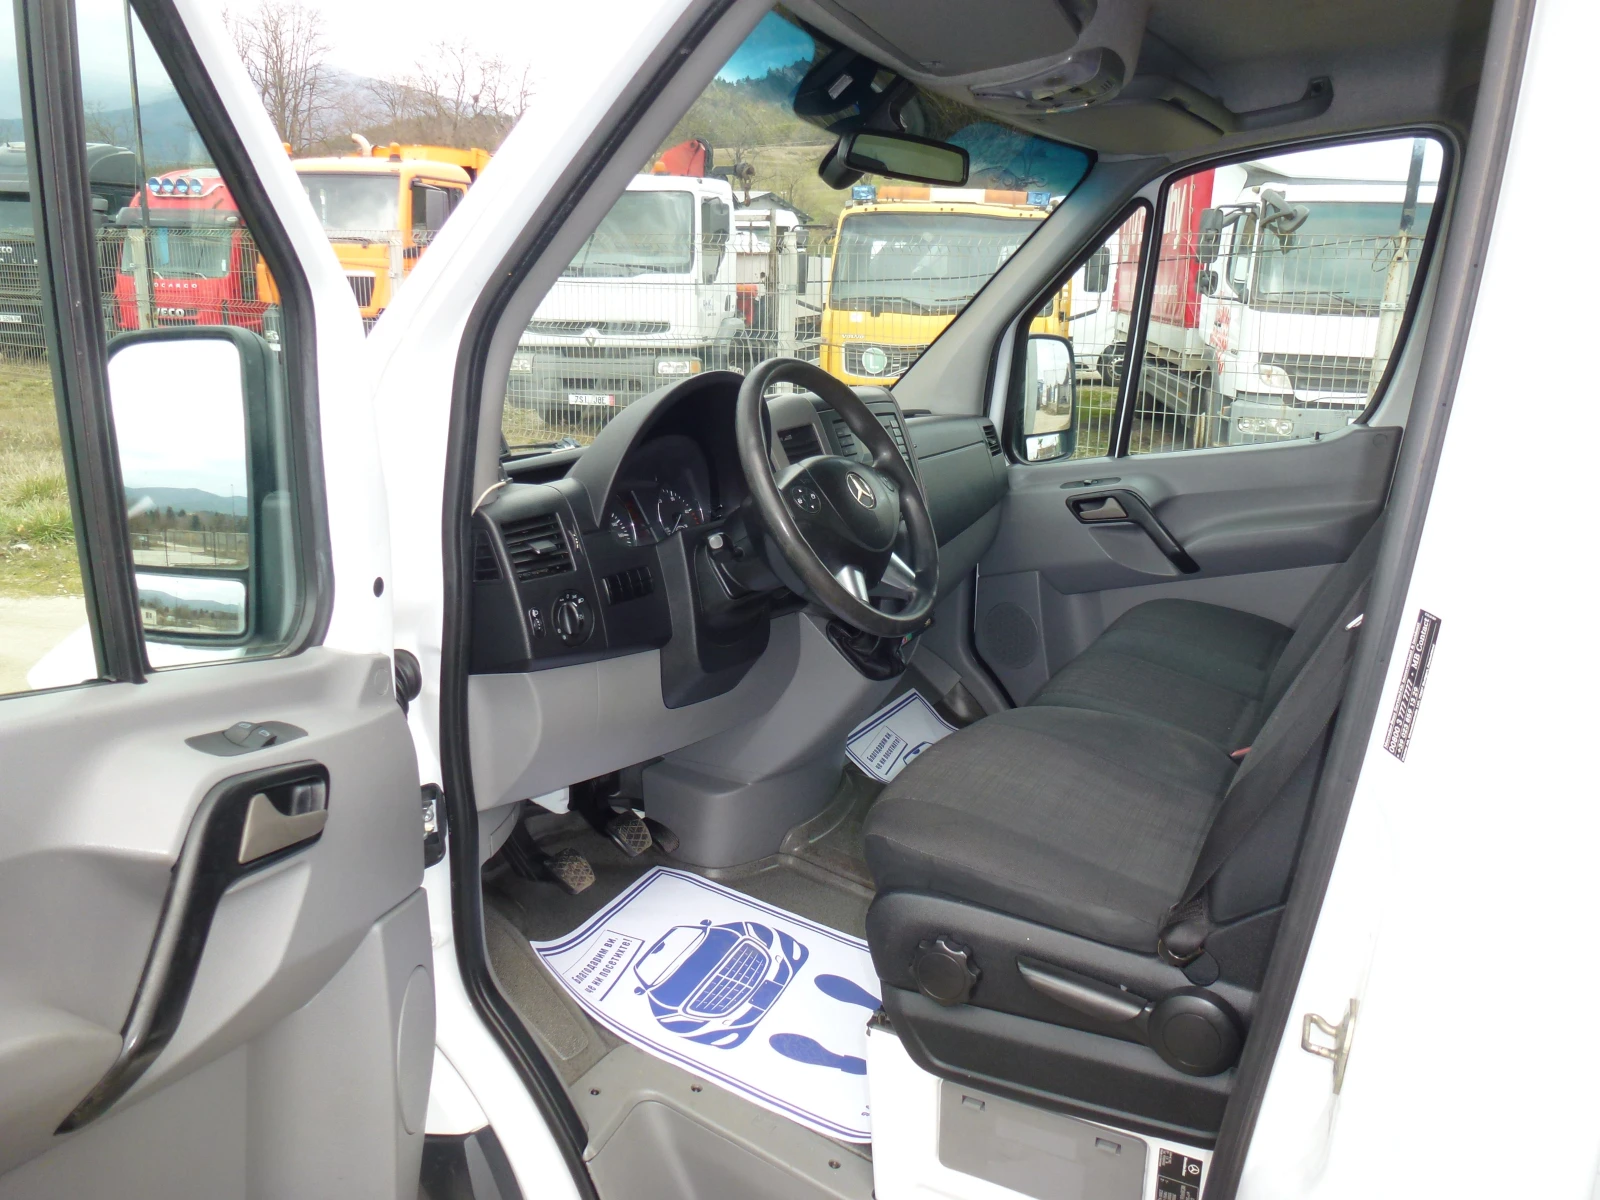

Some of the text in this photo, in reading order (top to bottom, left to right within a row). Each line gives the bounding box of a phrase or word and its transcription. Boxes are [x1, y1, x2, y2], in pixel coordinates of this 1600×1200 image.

[1415, 616, 1430, 652] Contact
[1411, 651, 1420, 669] MB
[1402, 677, 1413, 701] 7777
[1412, 685, 1418, 697] 29
[1397, 700, 1407, 718] 777
[1409, 696, 1416, 707] 13
[1395, 717, 1402, 726] 3
[1388, 724, 1400, 754] 00800
[571, 948, 609, 984] Благодарим
[591, 976, 604, 986] ни
[599, 938, 632, 978] посетихте!
